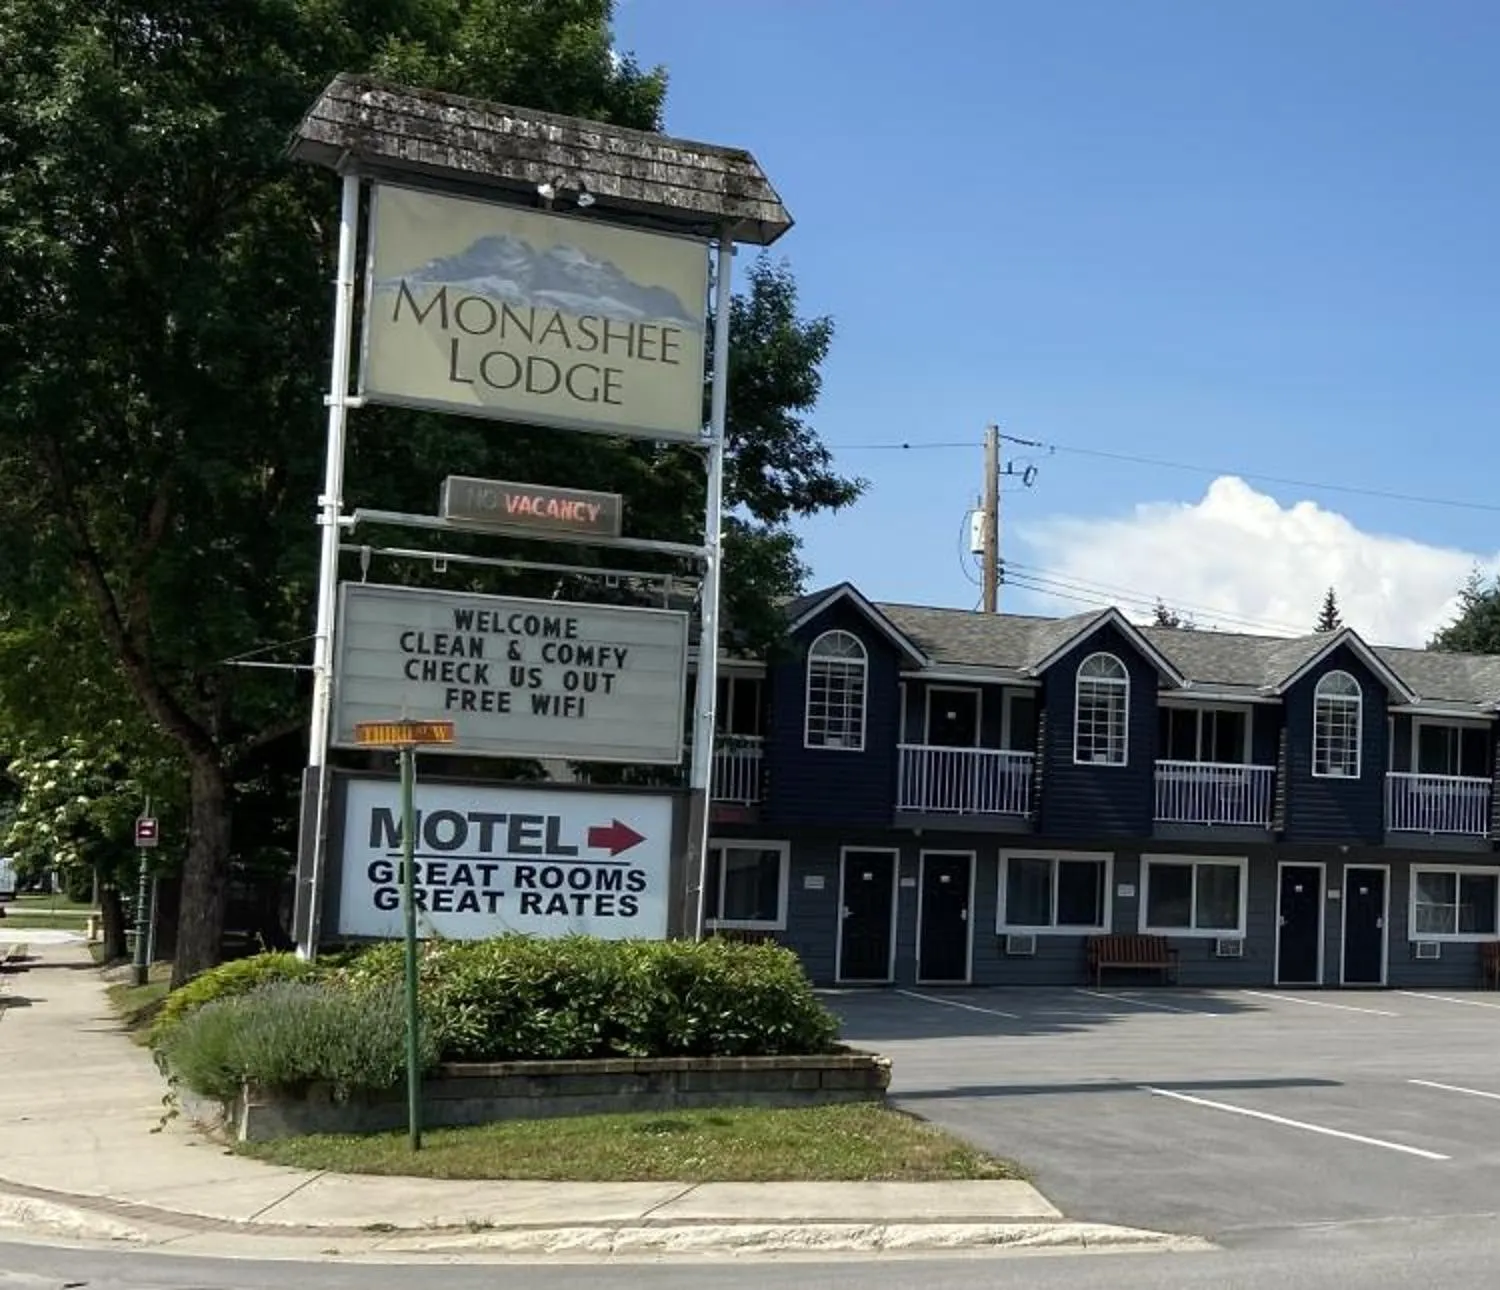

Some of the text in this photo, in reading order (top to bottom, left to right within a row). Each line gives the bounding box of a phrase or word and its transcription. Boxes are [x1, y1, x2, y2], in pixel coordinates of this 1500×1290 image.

[393, 279, 681, 365] MONASHEE
[449, 337, 624, 405] LODGE
[505, 493, 600, 522] VACANCY
[454, 608, 578, 639] WELCOME
[400, 631, 629, 669] CLEAN & COMFY
[404, 659, 616, 694] CHECK US OUT
[445, 688, 585, 718] FREE WIFI
[369, 807, 579, 857] MOTEL
[367, 860, 647, 892] GREAT ROOMS
[520, 892, 639, 917] RATES
